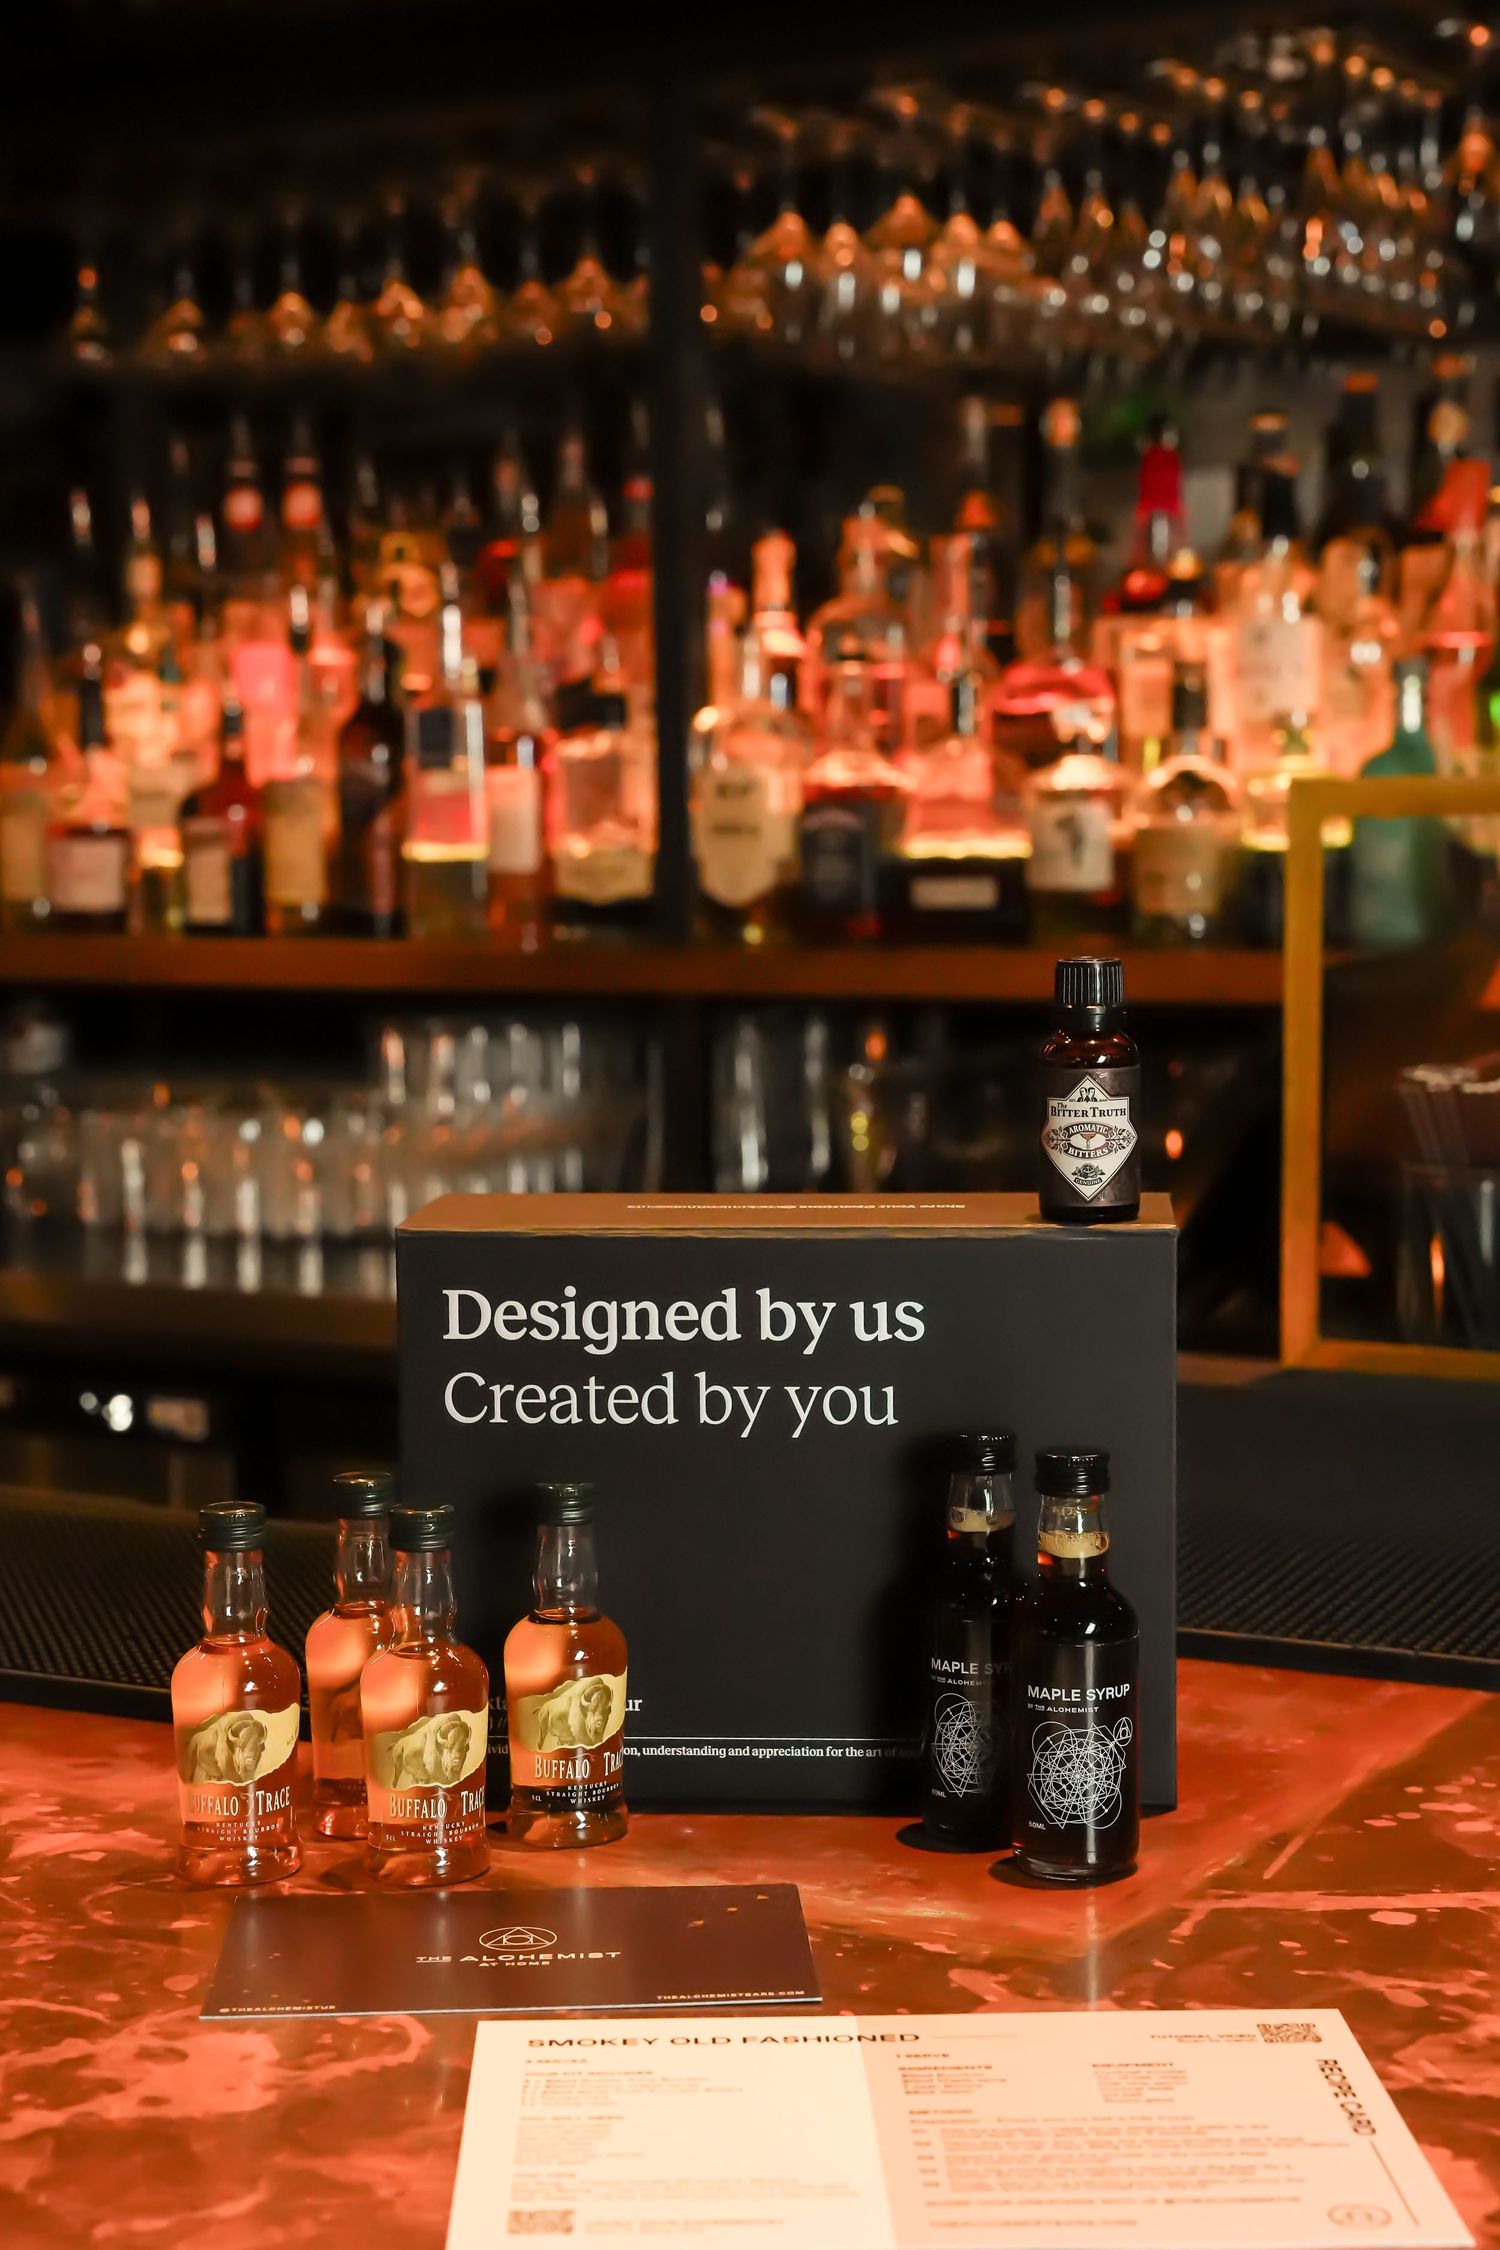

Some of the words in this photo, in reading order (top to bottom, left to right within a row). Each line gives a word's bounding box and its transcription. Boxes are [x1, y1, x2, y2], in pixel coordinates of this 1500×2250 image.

[1050, 1106, 1089, 1118] BITTER
[1090, 1106, 1127, 1118] TRUTH
[1068, 1123, 1109, 1135] AROMATIC
[1067, 1145, 1109, 1158] BITTERS
[442, 1285, 742, 1355] Designed
[756, 1287, 837, 1355] by
[849, 1301, 926, 1342] us
[443, 1371, 680, 1426] Created
[694, 1371, 771, 1439] by
[783, 1385, 899, 1439] you
[931, 1657, 979, 1675] MAPLE
[1027, 1684, 1082, 1702] MAPLE
[1085, 1683, 1131, 1701] SYRUP
[1046, 1701, 1099, 1713] ALCHEMIST
[642, 1745, 727, 1759] understanding
[727, 1745, 750, 1756] and
[751, 1745, 825, 1759] appreciation
[826, 1745, 844, 1757] for
[845, 1746, 865, 1757] the
[865, 1747, 882, 1758] art
[535, 1755, 592, 1779] BUFFALO
[567, 1780, 608, 1791] KENTUCKY
[546, 1790, 588, 1798] STRAIGHT
[570, 1794, 606, 1804] WHISKEY
[255, 1786, 290, 1816] TRACE
[389, 1792, 447, 1819] BUFFALO
[243, 1823, 280, 1835] BOURBON
[400, 1830, 444, 1838] STRAIGHT
[448, 1822, 480, 1836] BOURBON
[422, 1821, 466, 1831] KENTUCKY
[1028, 1820, 1047, 1831] 50ML
[425, 1835, 463, 1845] WHISKEY
[459, 1951, 622, 1962] ALCHEMIST
[527, 2036, 660, 2048] SMOKEY
[670, 2036, 731, 2046] OLD
[742, 2032, 921, 2044] FASHIONED
[1316, 2058, 1357, 2098] RECIPE
[1339, 2101, 1377, 2137] CARD
